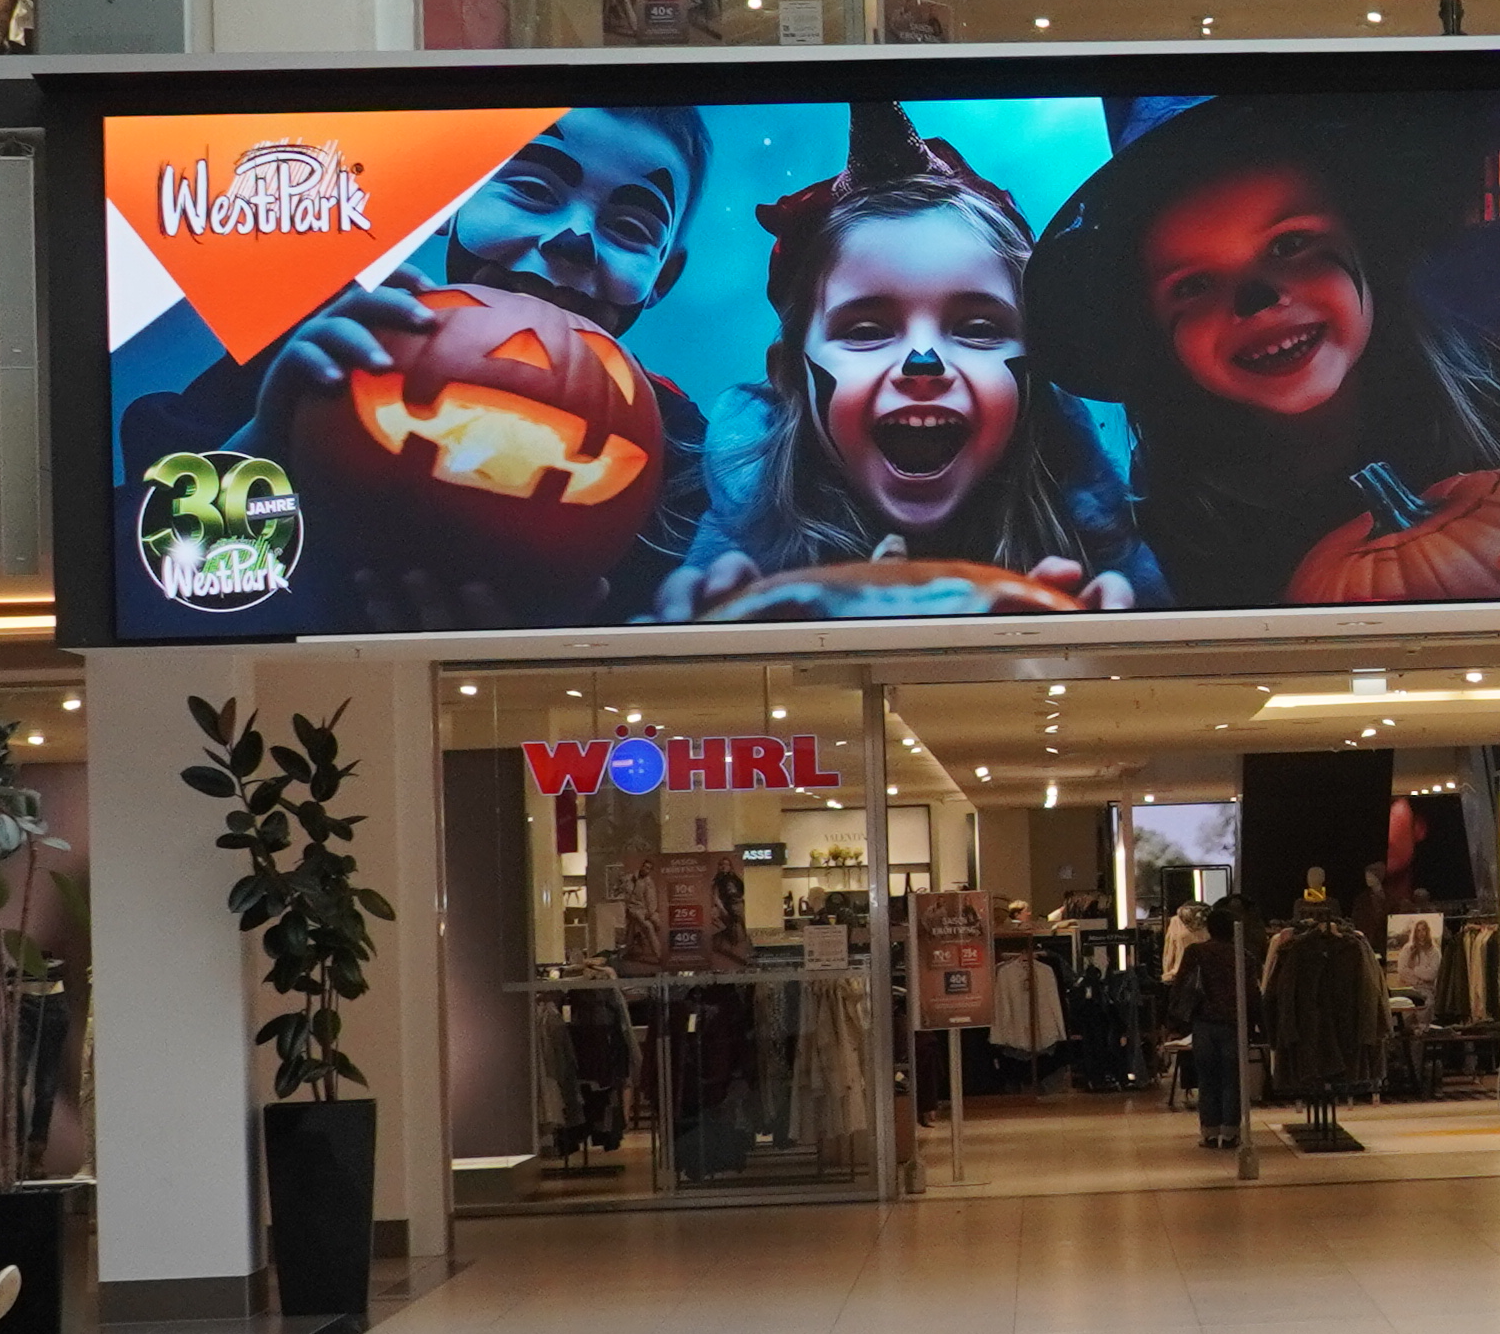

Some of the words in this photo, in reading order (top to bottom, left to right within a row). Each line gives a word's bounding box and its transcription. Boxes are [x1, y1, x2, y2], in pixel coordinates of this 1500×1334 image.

[158, 147, 373, 237] WestPark
[143, 451, 297, 557] 30
[245, 497, 297, 517] JAHRE
[162, 543, 291, 600] WestPark
[521, 724, 842, 796] WÖHRL
[742, 849, 773, 860] ASSE
